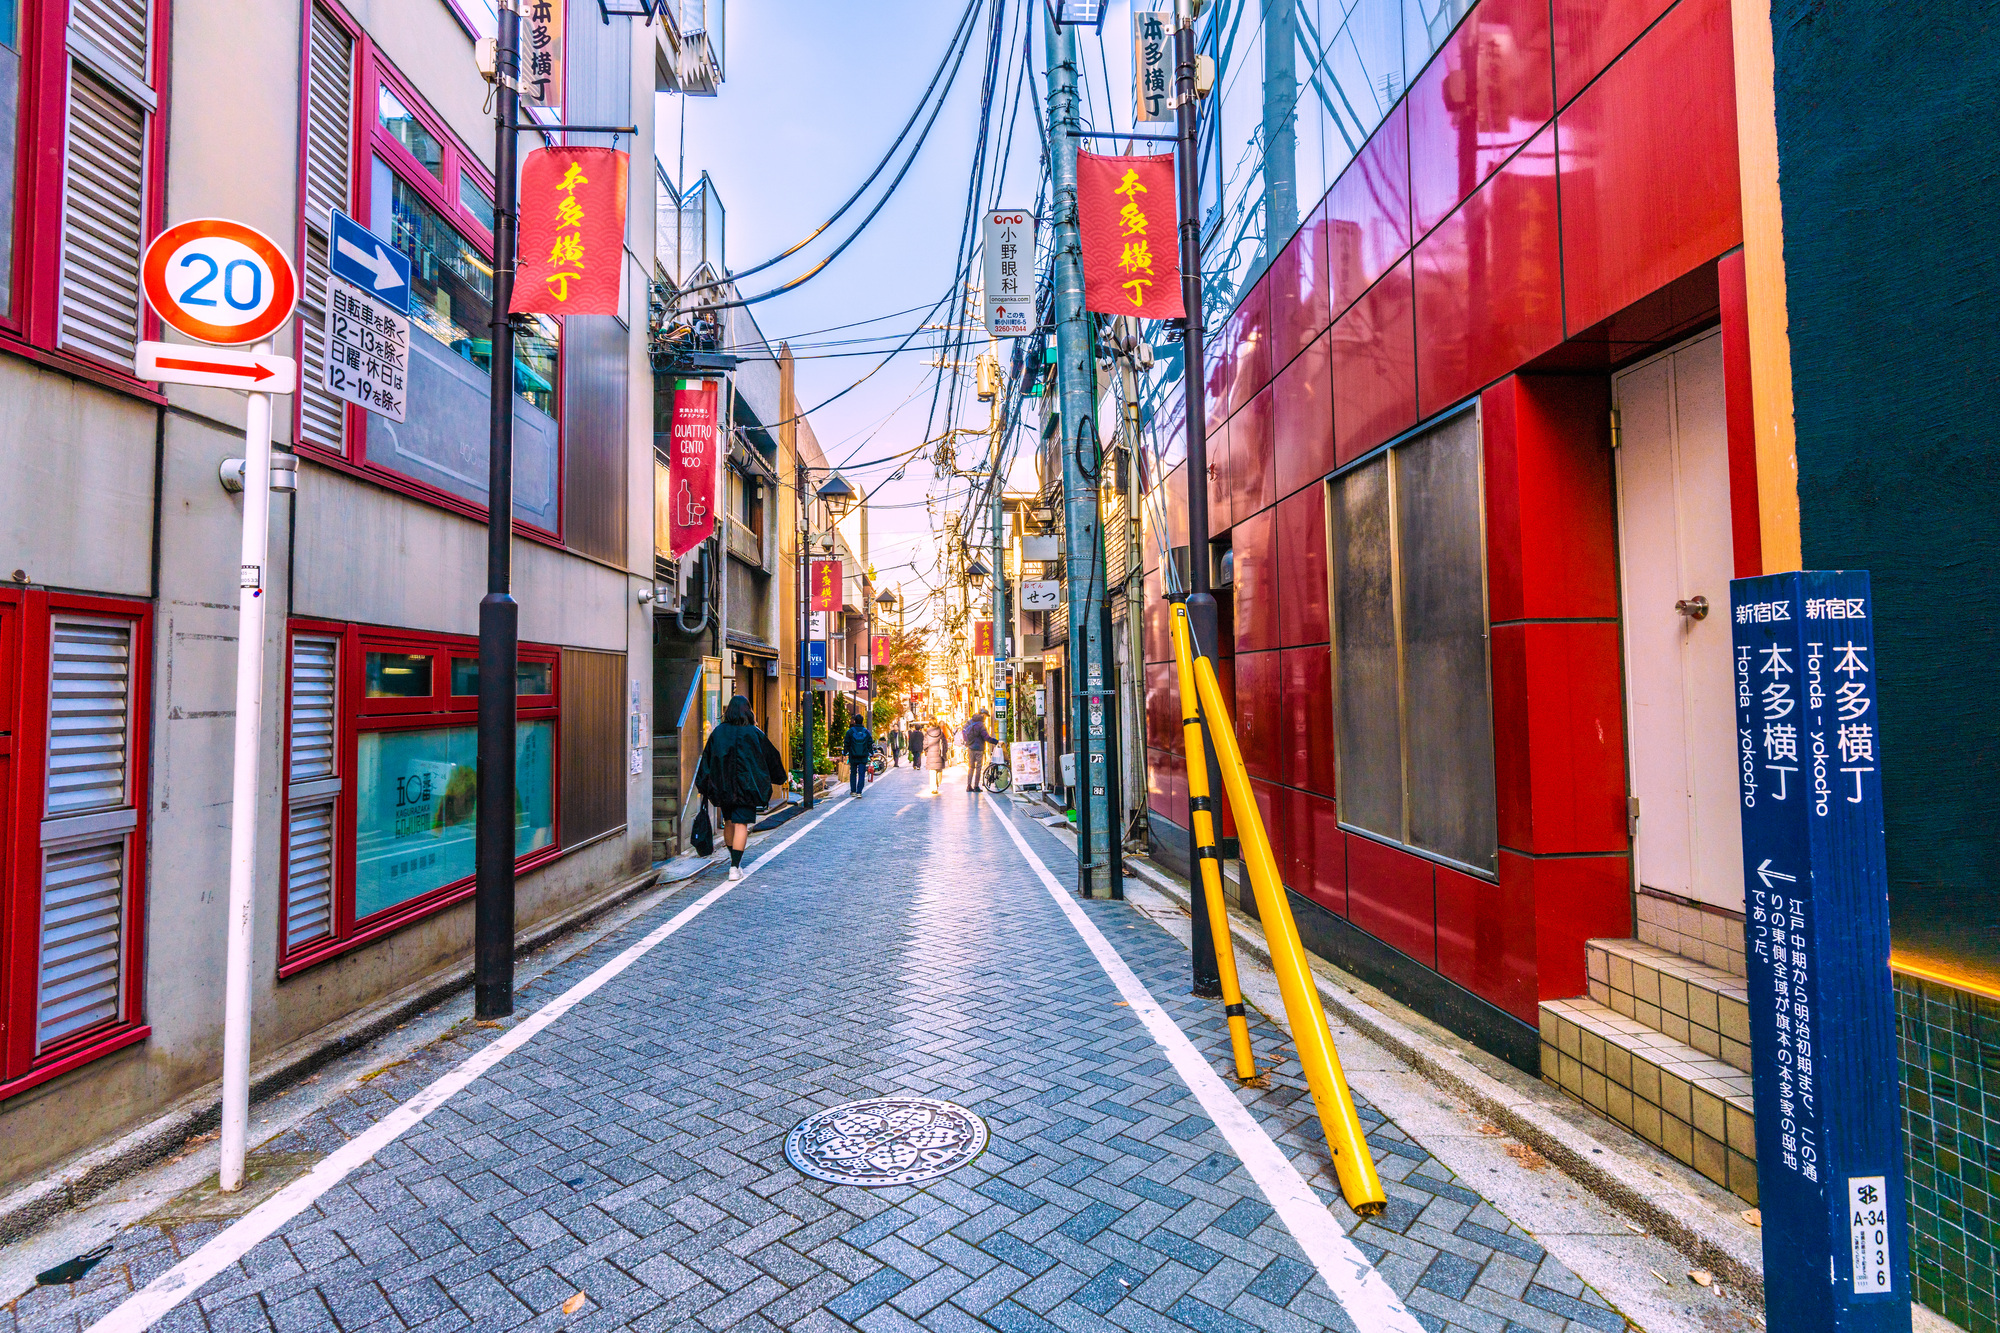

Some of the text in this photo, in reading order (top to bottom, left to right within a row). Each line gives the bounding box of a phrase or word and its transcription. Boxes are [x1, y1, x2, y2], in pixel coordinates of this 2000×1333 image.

[531, 0, 552, 102] 本多横丁
[1143, 17, 1165, 117] 本多横丁
[545, 161, 588, 302] 本多横丁
[1001, 226, 1018, 294] 小野眼科
[1114, 168, 1155, 307] 本多横丁
[179, 252, 262, 311] 20
[333, 289, 405, 344] 自転車を除く
[674, 423, 712, 440] QUATTRO
[680, 440, 704, 454] CENTO
[681, 456, 701, 468] 400
[821, 564, 832, 608] 本多横丁
[1027, 590, 1056, 604] せつ
[1735, 600, 1791, 625] 新宿区
[1805, 597, 1867, 619] 新宿区
[1737, 645, 1753, 708] Honda
[1807, 642, 1827, 710] Honda
[1758, 642, 1799, 801] 本多横丁
[1833, 640, 1875, 804] 本多横丁
[1739, 728, 1758, 808] yokocho
[1810, 731, 1832, 817] yokocho
[1752, 889, 1769, 964] であった。
[1853, 1210, 1885, 1227] A-34
